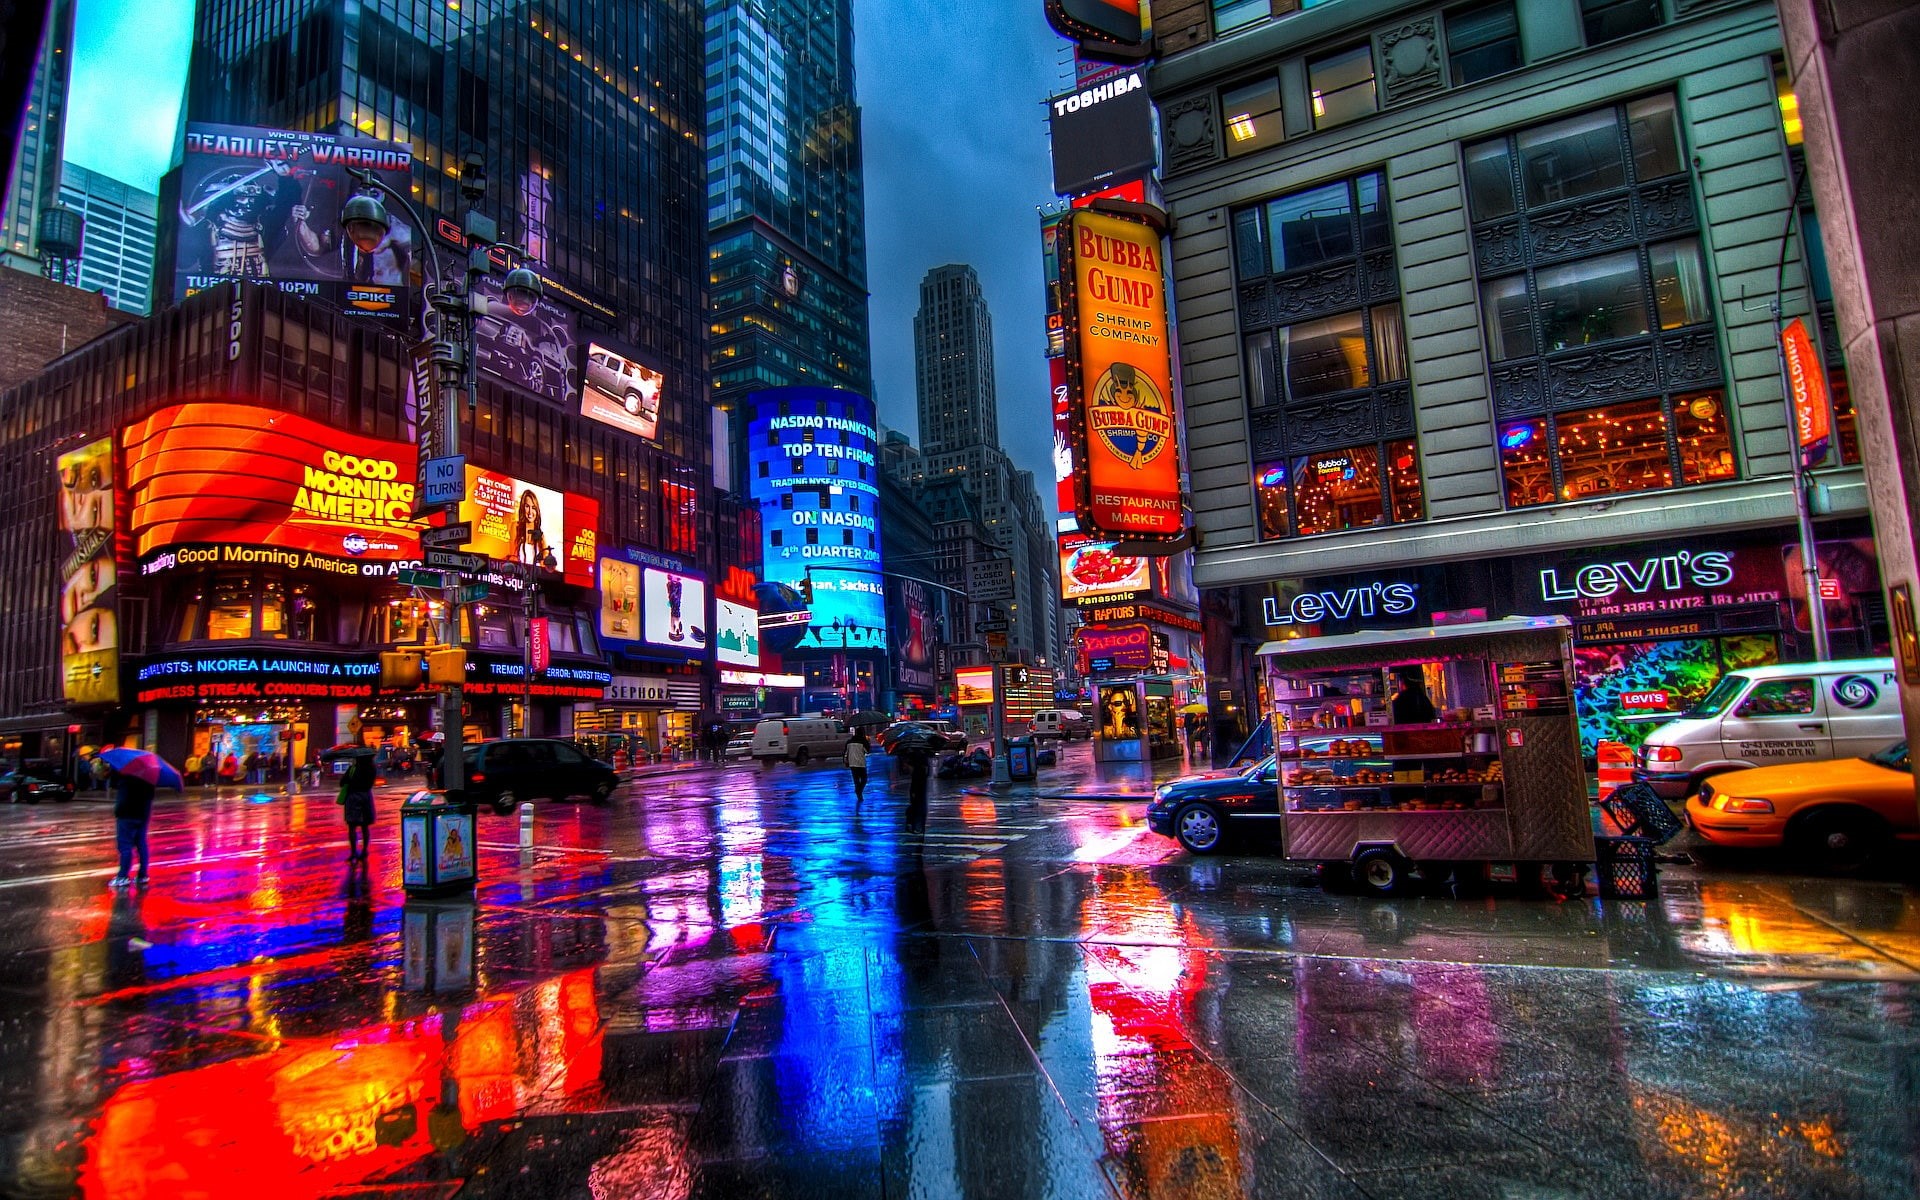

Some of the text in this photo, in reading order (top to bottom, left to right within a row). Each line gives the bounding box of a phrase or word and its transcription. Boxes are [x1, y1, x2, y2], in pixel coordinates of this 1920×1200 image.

[1054, 73, 1142, 116] TOSHIBA
[268, 131, 336, 143] WHO IS THE
[187, 133, 411, 172] DEADLIEST WARRIOR
[438, 218, 505, 267] GC
[1078, 225, 1158, 272] BUBBA
[279, 281, 319, 294] 10PM
[1088, 267, 1154, 308] GUMP
[346, 291, 396, 303] SPIKE
[1096, 312, 1152, 330] SHRIMP
[1090, 325, 1159, 346] COMPANY
[415, 357, 431, 426] VENIT
[770, 416, 823, 429] NASDAQ
[825, 417, 867, 437] THANKS
[1092, 410, 1169, 434] BUBBA GUMP
[1107, 429, 1136, 437] SHRIMP
[782, 443, 875, 467] TOP TEN FIRMS
[323, 450, 398, 480] GOOD
[437, 464, 454, 478] NO
[304, 465, 415, 502] MORNING
[427, 481, 463, 497] TURNS
[770, 478, 808, 487] TRADING
[1095, 494, 1178, 511] RESTAURANT
[791, 511, 875, 532] ON NASDAQ
[1112, 512, 1165, 526] MARKET
[449, 528, 465, 538] WAY
[478, 524, 511, 540] AMERICA
[343, 536, 368, 550] abc
[433, 554, 479, 566] ONE WAY
[627, 548, 683, 572] WRIGLEY'S
[781, 545, 799, 558] 4th
[802, 545, 862, 559] QUARTER
[177, 546, 219, 564] Good
[224, 546, 299, 568] Morning
[303, 553, 358, 574] America
[362, 564, 383, 575] on
[723, 565, 756, 601] JVC
[974, 571, 1003, 580] CLOSED
[840, 580, 868, 591] Sachs
[1077, 592, 1135, 605] Panasonic
[1094, 605, 1135, 621] RAPTORS
[533, 622, 541, 669] WELCOME
[1084, 631, 1147, 651] YAHOO!
[197, 660, 258, 672] NKOREA
[262, 660, 312, 673] LAUNCH
[313, 663, 330, 674] NOT
[332, 664, 341, 675] A
[490, 664, 524, 675] TREMOR
[198, 683, 261, 696] STREAK,
[329, 685, 372, 696] TEXAS
[611, 686, 672, 700] SEPHORA
[1764, 740, 1794, 748] VERNON
[1741, 749, 1760, 758] LONG
[1761, 748, 1786, 757] ISLAND
